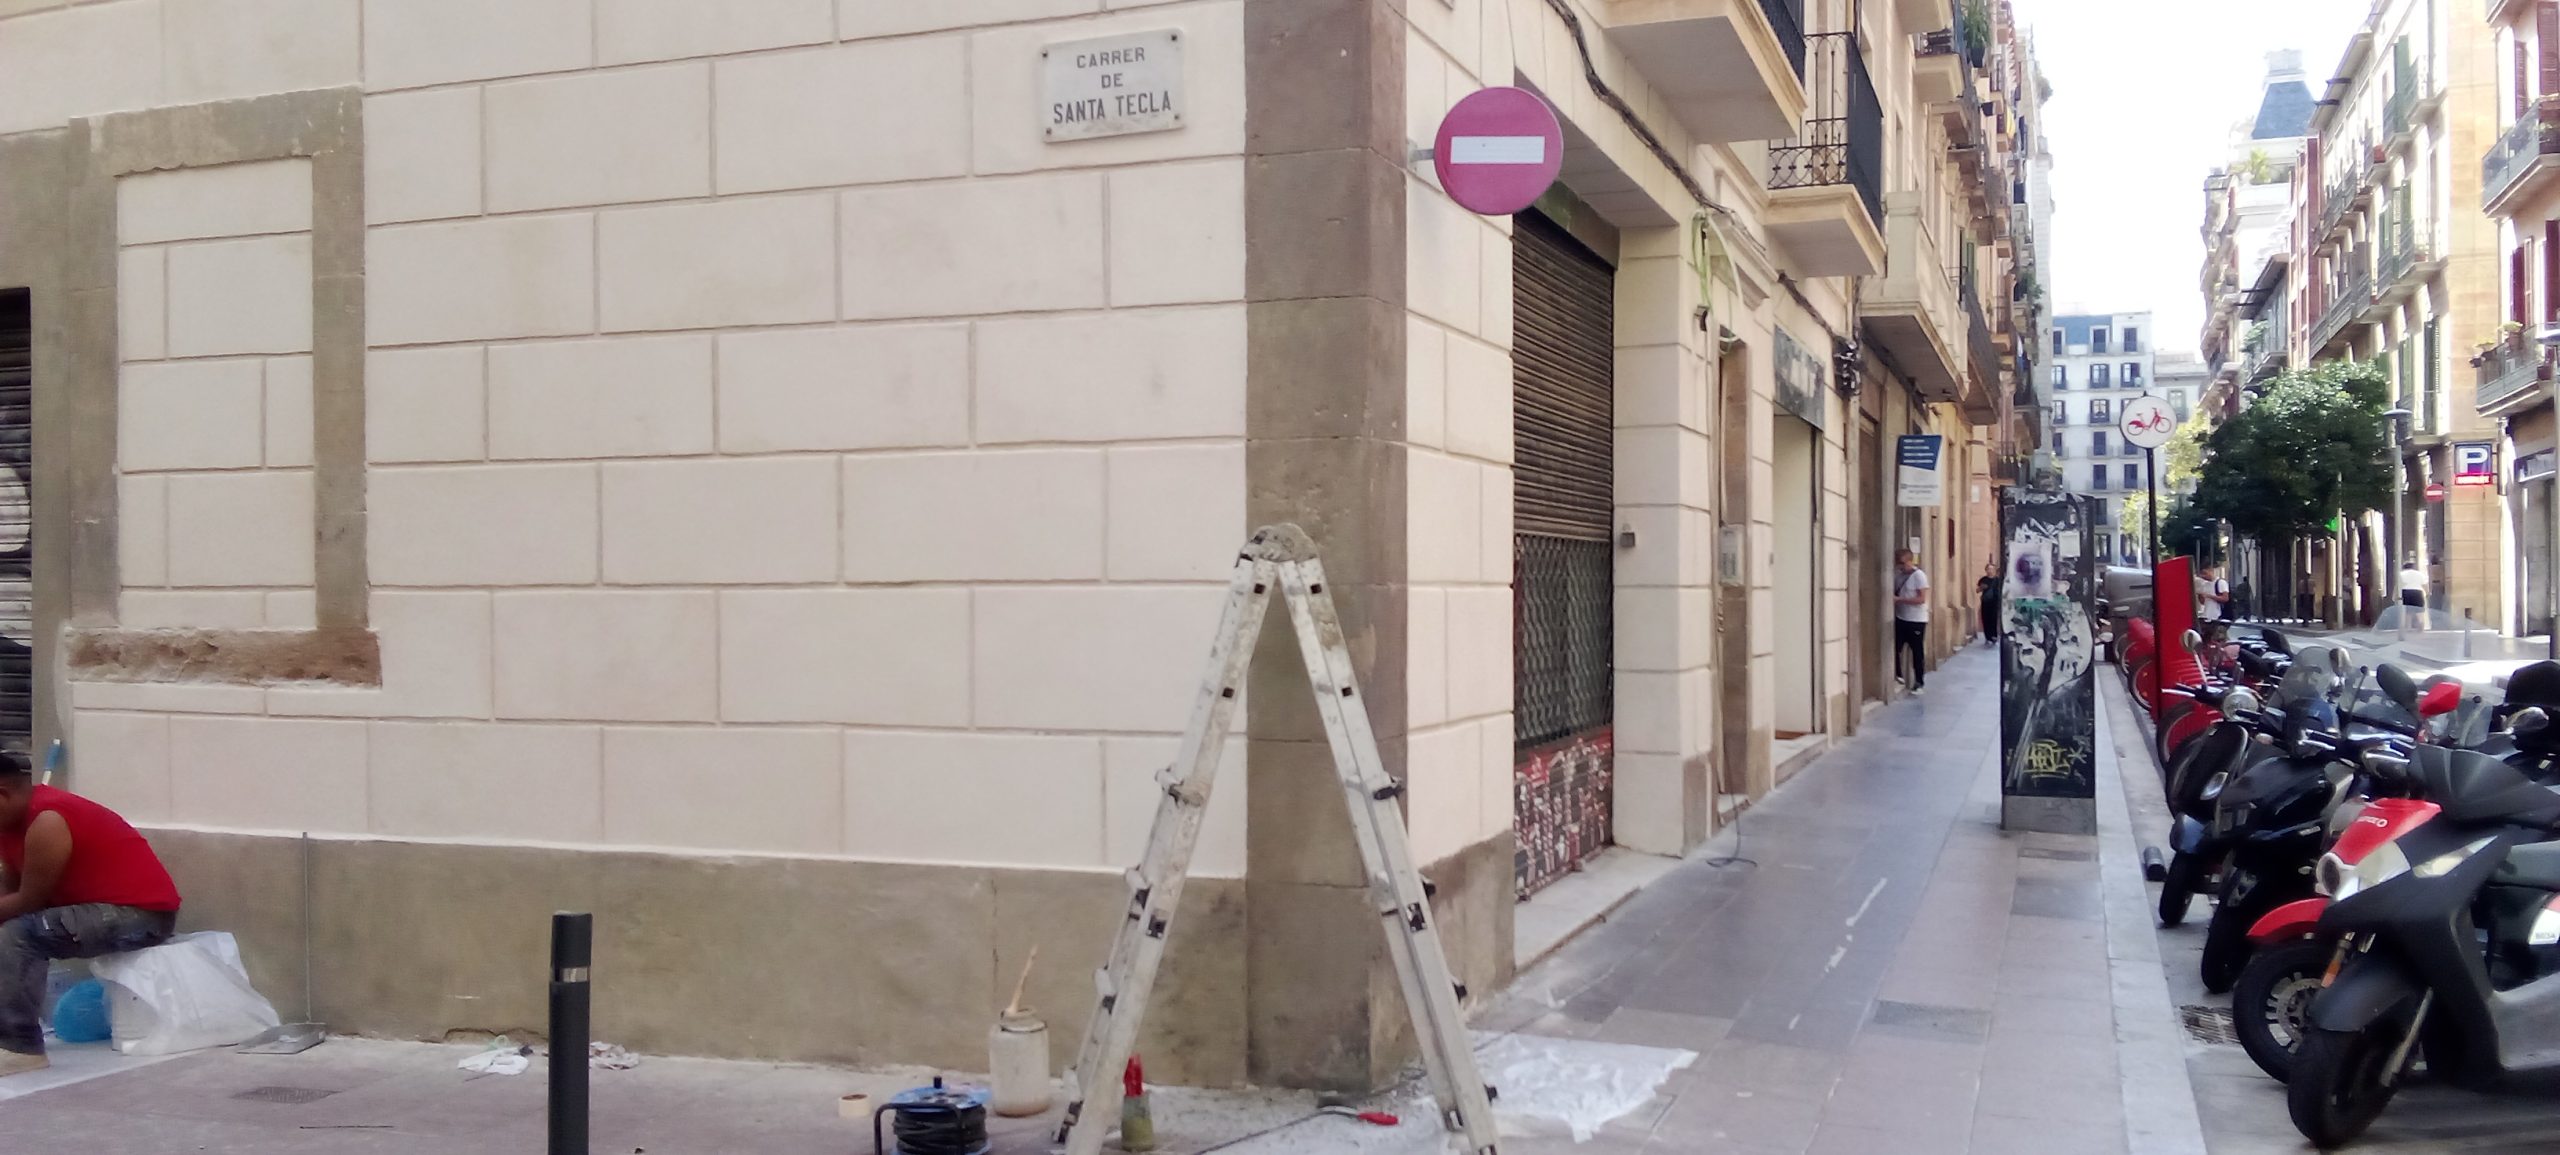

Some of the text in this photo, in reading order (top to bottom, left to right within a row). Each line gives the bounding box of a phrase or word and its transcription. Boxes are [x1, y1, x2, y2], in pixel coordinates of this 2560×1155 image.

[1077, 47, 1145, 69] CARRER
[1101, 73, 1124, 89] DE
[1053, 90, 1172, 125] SANTA TECLA
[2459, 447, 2488, 474] P
